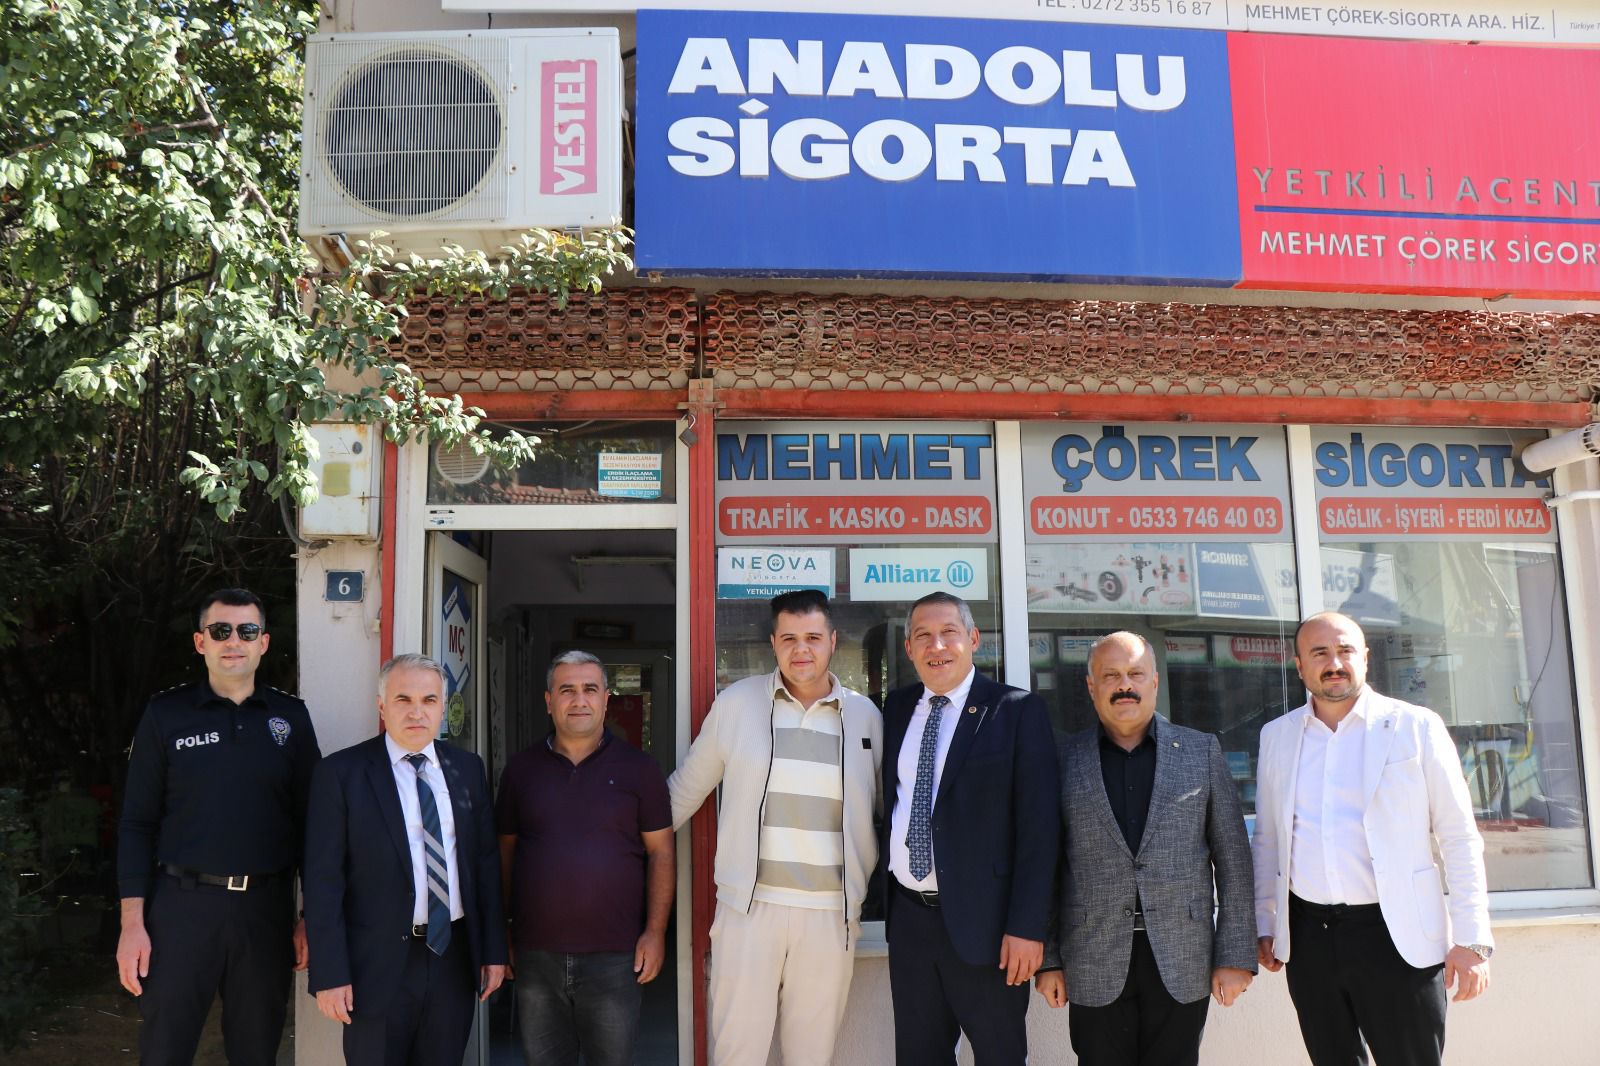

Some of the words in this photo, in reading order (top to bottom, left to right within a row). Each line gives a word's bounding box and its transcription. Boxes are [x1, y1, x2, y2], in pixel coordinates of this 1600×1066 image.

[1129, 0, 1161, 14] 355
[1167, 0, 1187, 16] 16
[1192, 1, 1212, 16] 87
[1246, 4, 1322, 23] MEHMET
[1467, 15, 1507, 30] ARA.
[1512, 14, 1545, 31] HİZ.
[667, 37, 1187, 111] ANADOLU
[553, 62, 586, 194] VESTEL
[667, 98, 1137, 188] SİGORTA
[1253, 164, 1434, 201] YETKİLİ
[1259, 231, 1387, 258] MEHMET
[1397, 230, 1497, 267] ÇÖREK
[1506, 234, 1600, 266] SİGOR
[717, 433, 993, 481] MEHMET
[1051, 425, 1262, 493] ÇÖREK
[727, 502, 810, 529] TRAFİK
[829, 506, 906, 530] KASKO
[925, 506, 984, 529] DASK
[1037, 507, 1111, 529] KONUT
[1129, 506, 1178, 528] 0533
[1183, 506, 1219, 528] 746
[1224, 506, 1248, 528] 40
[1253, 506, 1277, 528] 03
[1325, 504, 1383, 529] SAĞLIK
[1395, 503, 1445, 533] İŞYERİ
[1456, 503, 1501, 529] FERDİ
[1505, 508, 1546, 529] KAZA
[731, 553, 817, 572] NEOVA
[864, 564, 941, 583] Allianz
[338, 577, 350, 595] 6
[746, 586, 773, 595] YETKİLİ
[449, 625, 465, 662] MÇ
